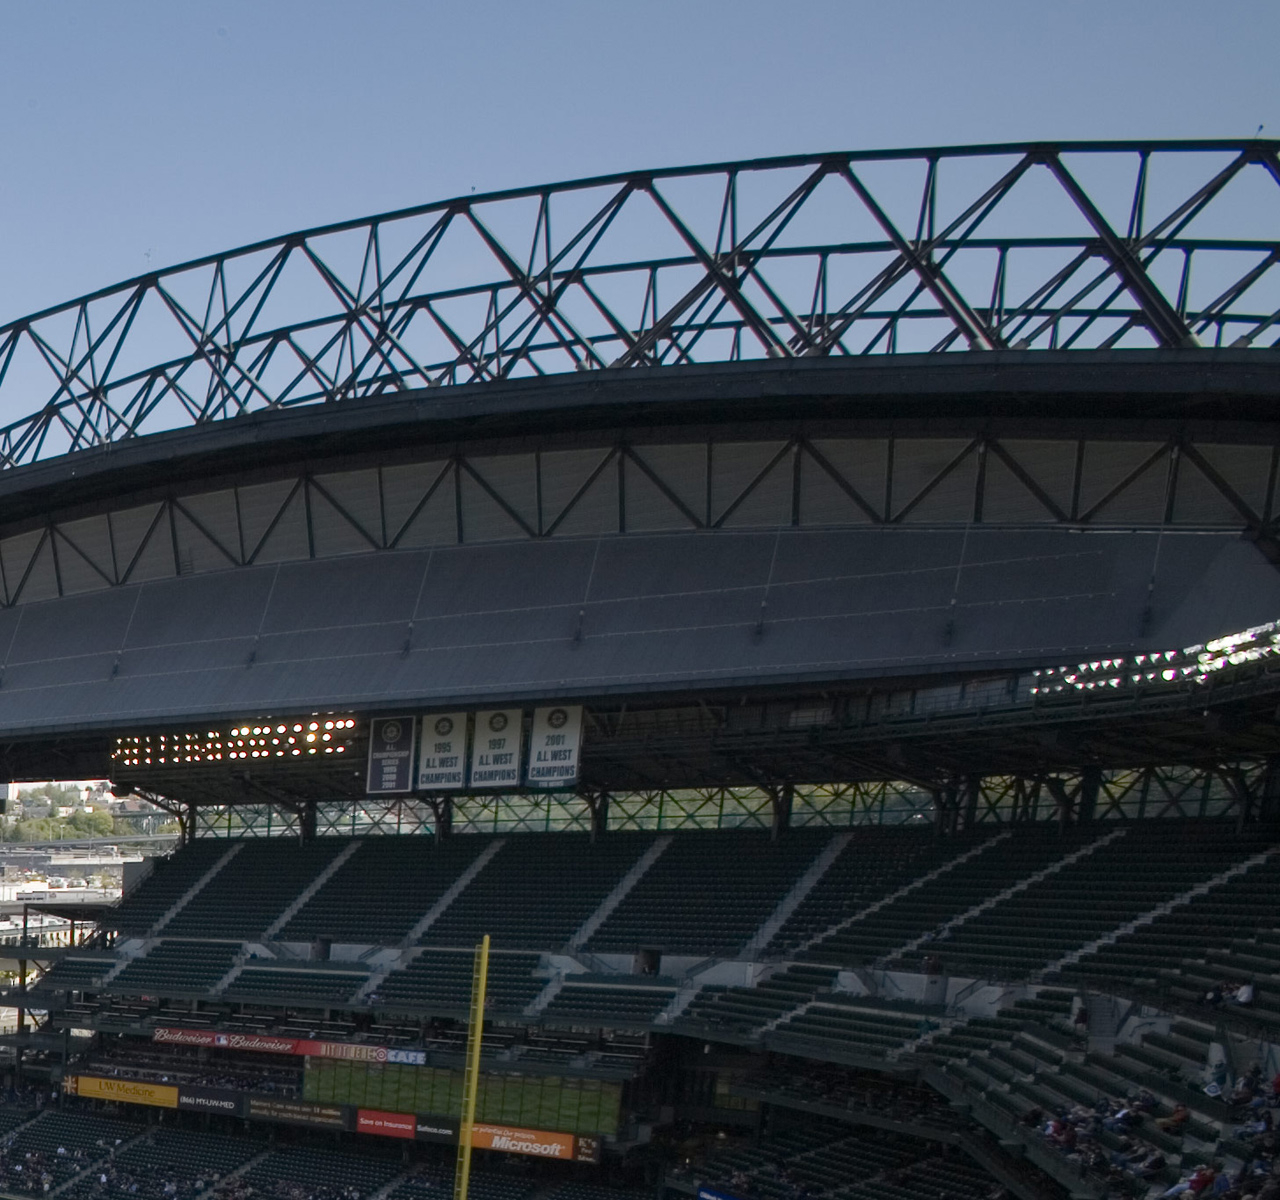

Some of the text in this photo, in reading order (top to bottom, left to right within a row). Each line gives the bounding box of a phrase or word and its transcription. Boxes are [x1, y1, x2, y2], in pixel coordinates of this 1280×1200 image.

[488, 738, 505, 749] 1997
[545, 734, 565, 746] 2001
[494, 753, 514, 765] WEST
[551, 749, 572, 761] WEST
[440, 756, 458, 768] WEST
[421, 771, 461, 785] CHAMPIONS
[473, 769, 516, 782] CHAMPIONS
[530, 765, 575, 778] CHAMPIONS
[154, 1028, 293, 1051] Budweiser Budweiser
[387, 1048, 426, 1065] CAFE
[98, 1081, 155, 1098] UW Medicine
[359, 1117, 375, 1126] Save
[383, 1120, 413, 1131] Insurance
[491, 1135, 561, 1157] Microsoft
